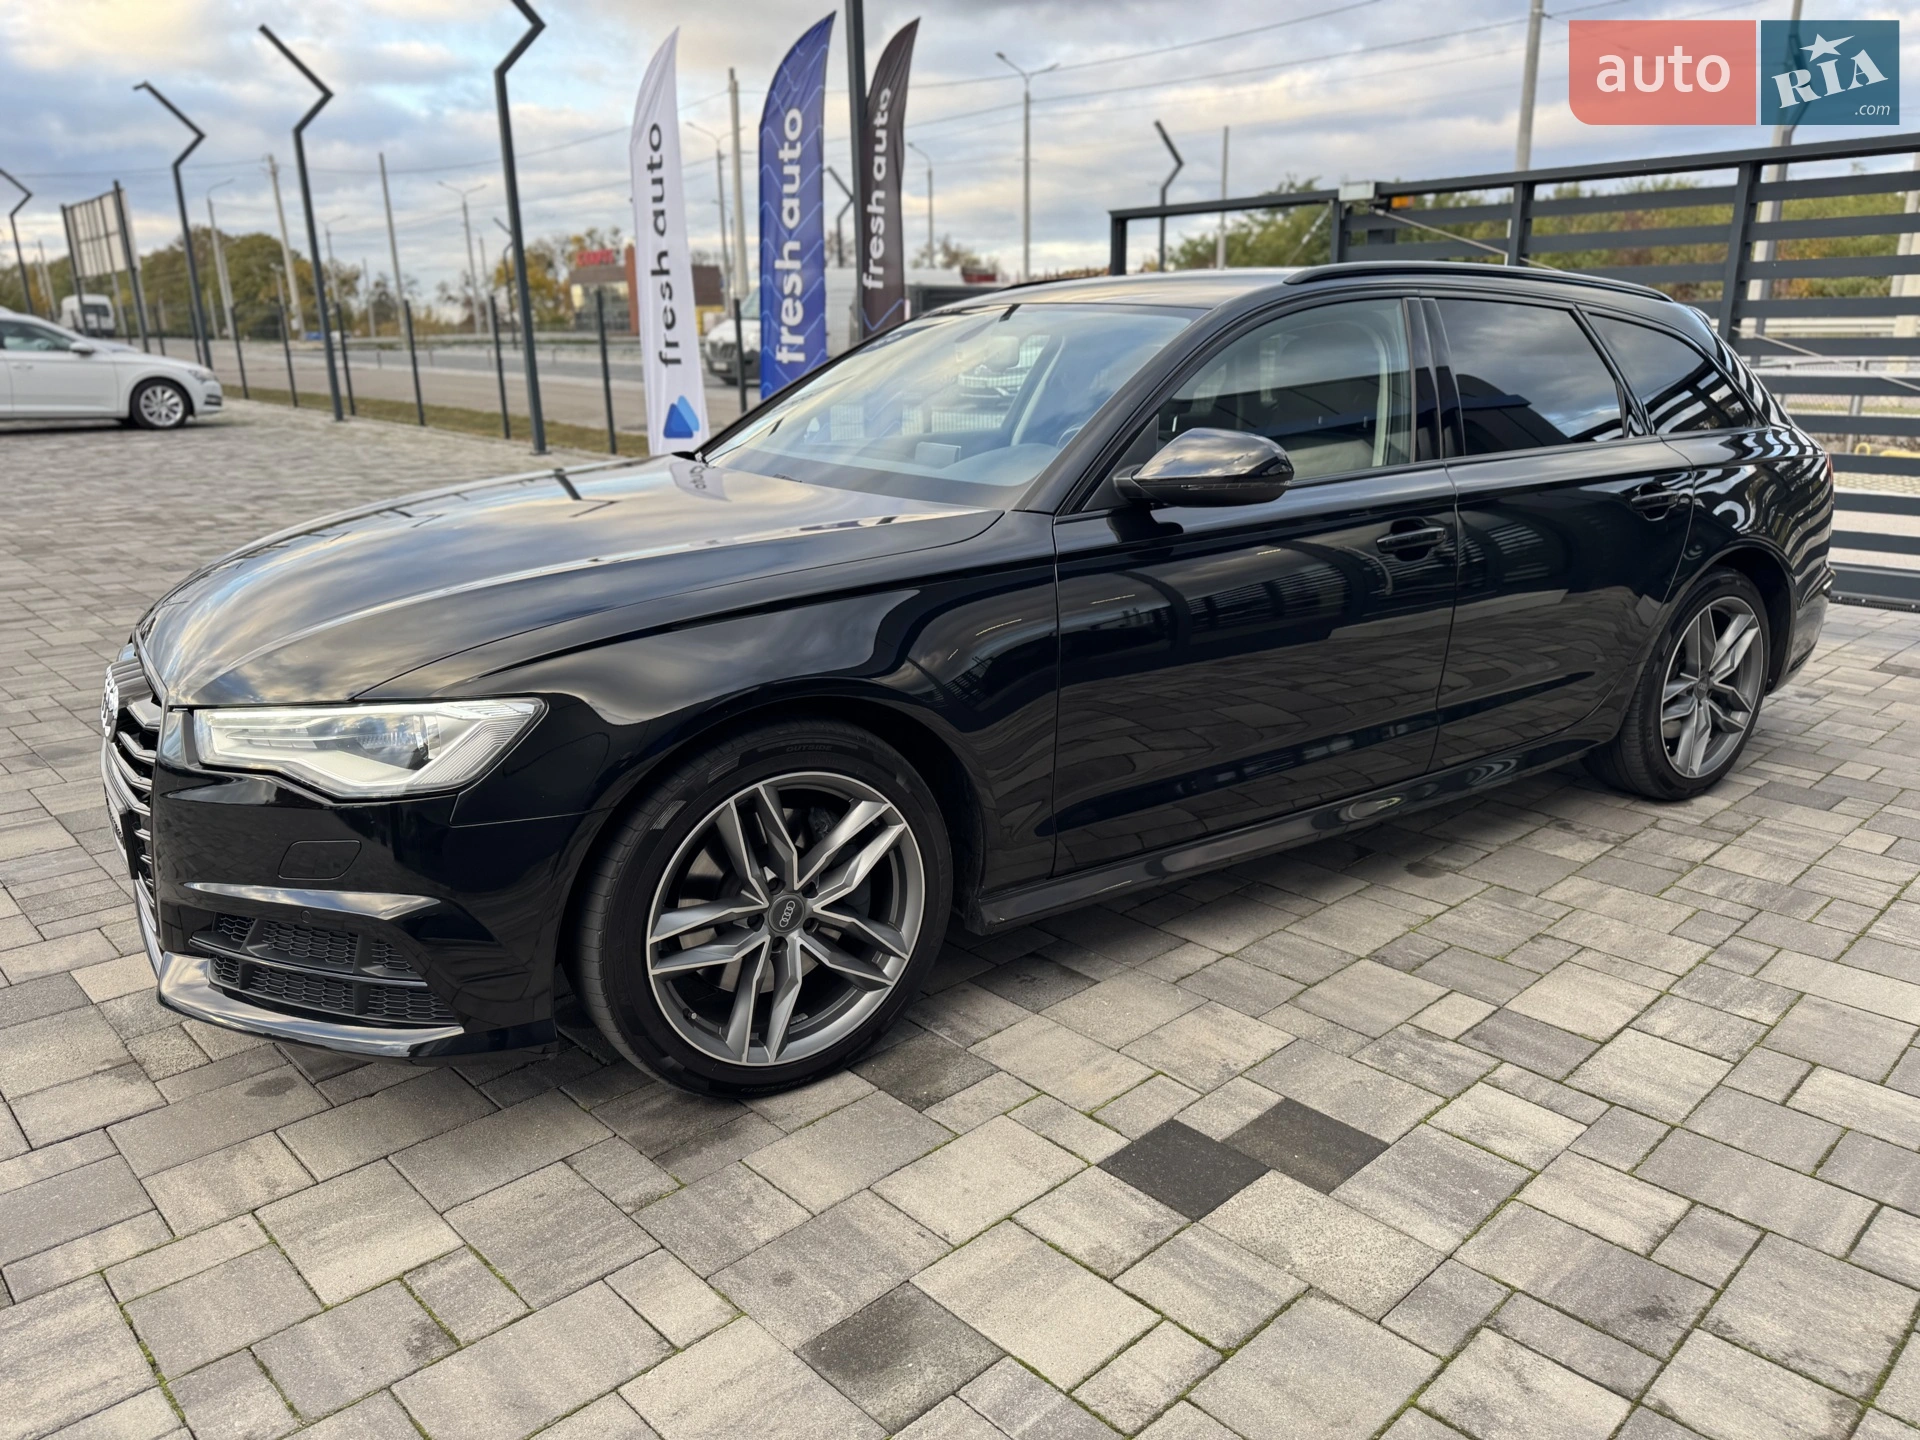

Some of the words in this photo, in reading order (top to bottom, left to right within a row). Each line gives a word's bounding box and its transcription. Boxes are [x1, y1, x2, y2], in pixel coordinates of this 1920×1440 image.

[647, 122, 667, 238] auto
[778, 107, 803, 230] auto
[872, 87, 892, 182] auto
[863, 189, 887, 290] fresh
[651, 248, 682, 368] fresh
[774, 240, 806, 365] fresh
[785, 744, 834, 753] OUTSIDE
